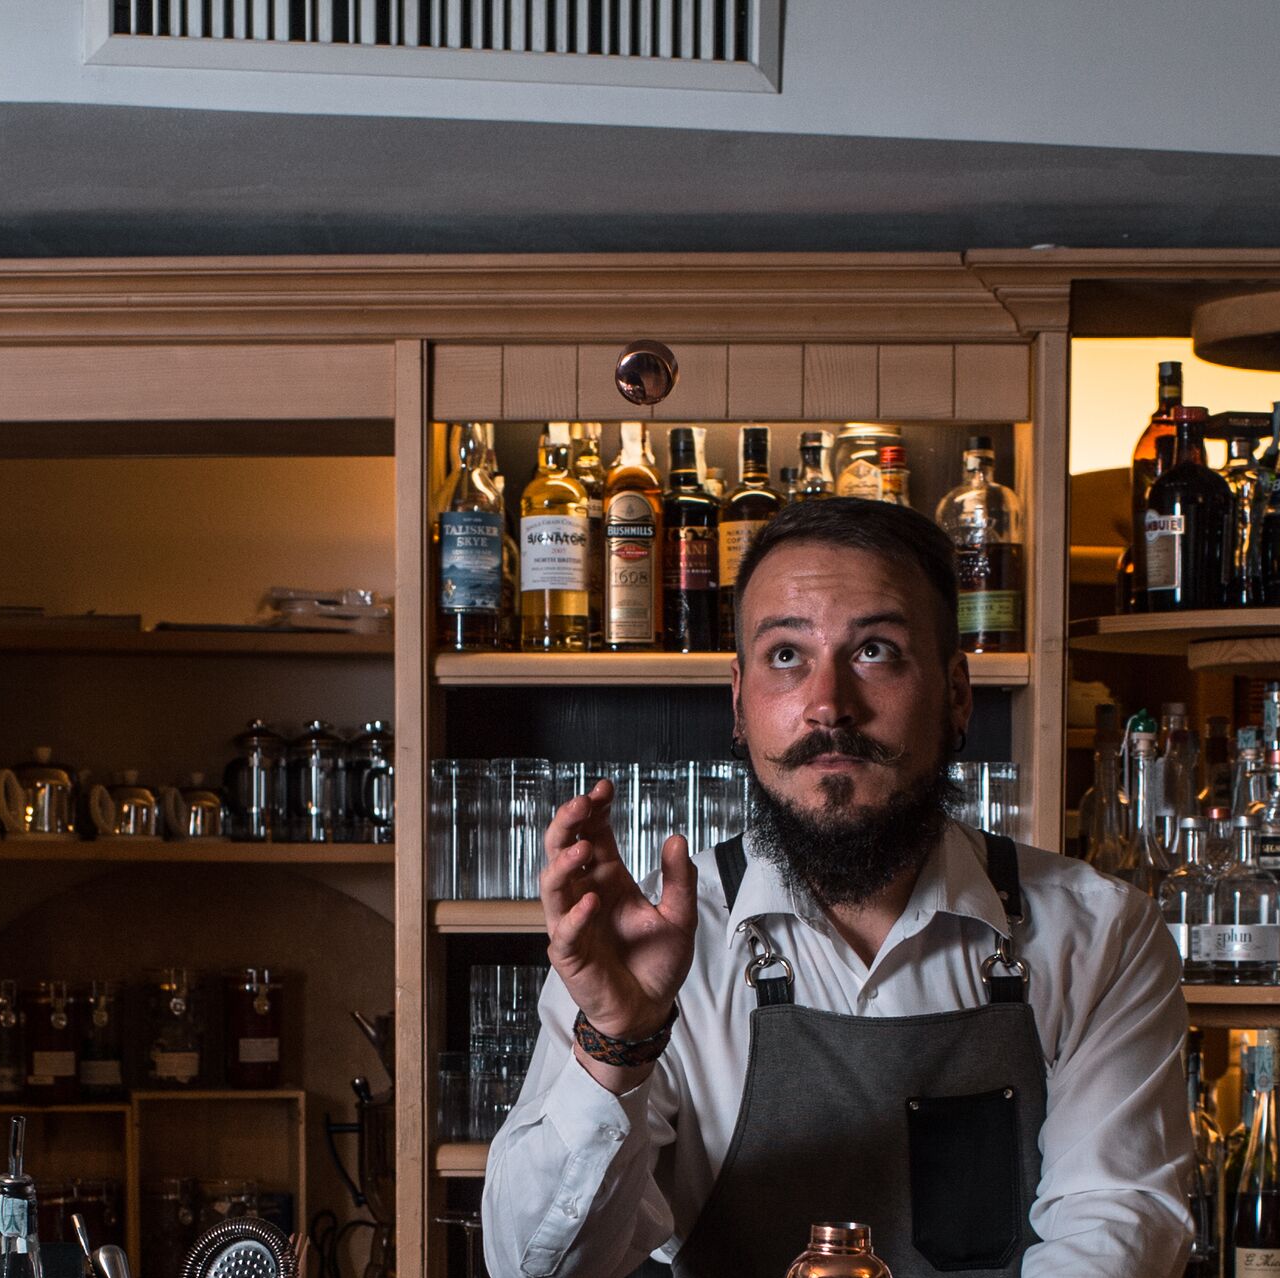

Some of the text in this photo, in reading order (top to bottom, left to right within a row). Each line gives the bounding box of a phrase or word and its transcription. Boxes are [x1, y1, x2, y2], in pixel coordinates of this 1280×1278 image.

[444, 524, 500, 536] TALISKER
[607, 525, 654, 538] BUSHMILLS
[456, 536, 488, 548] SKYE
